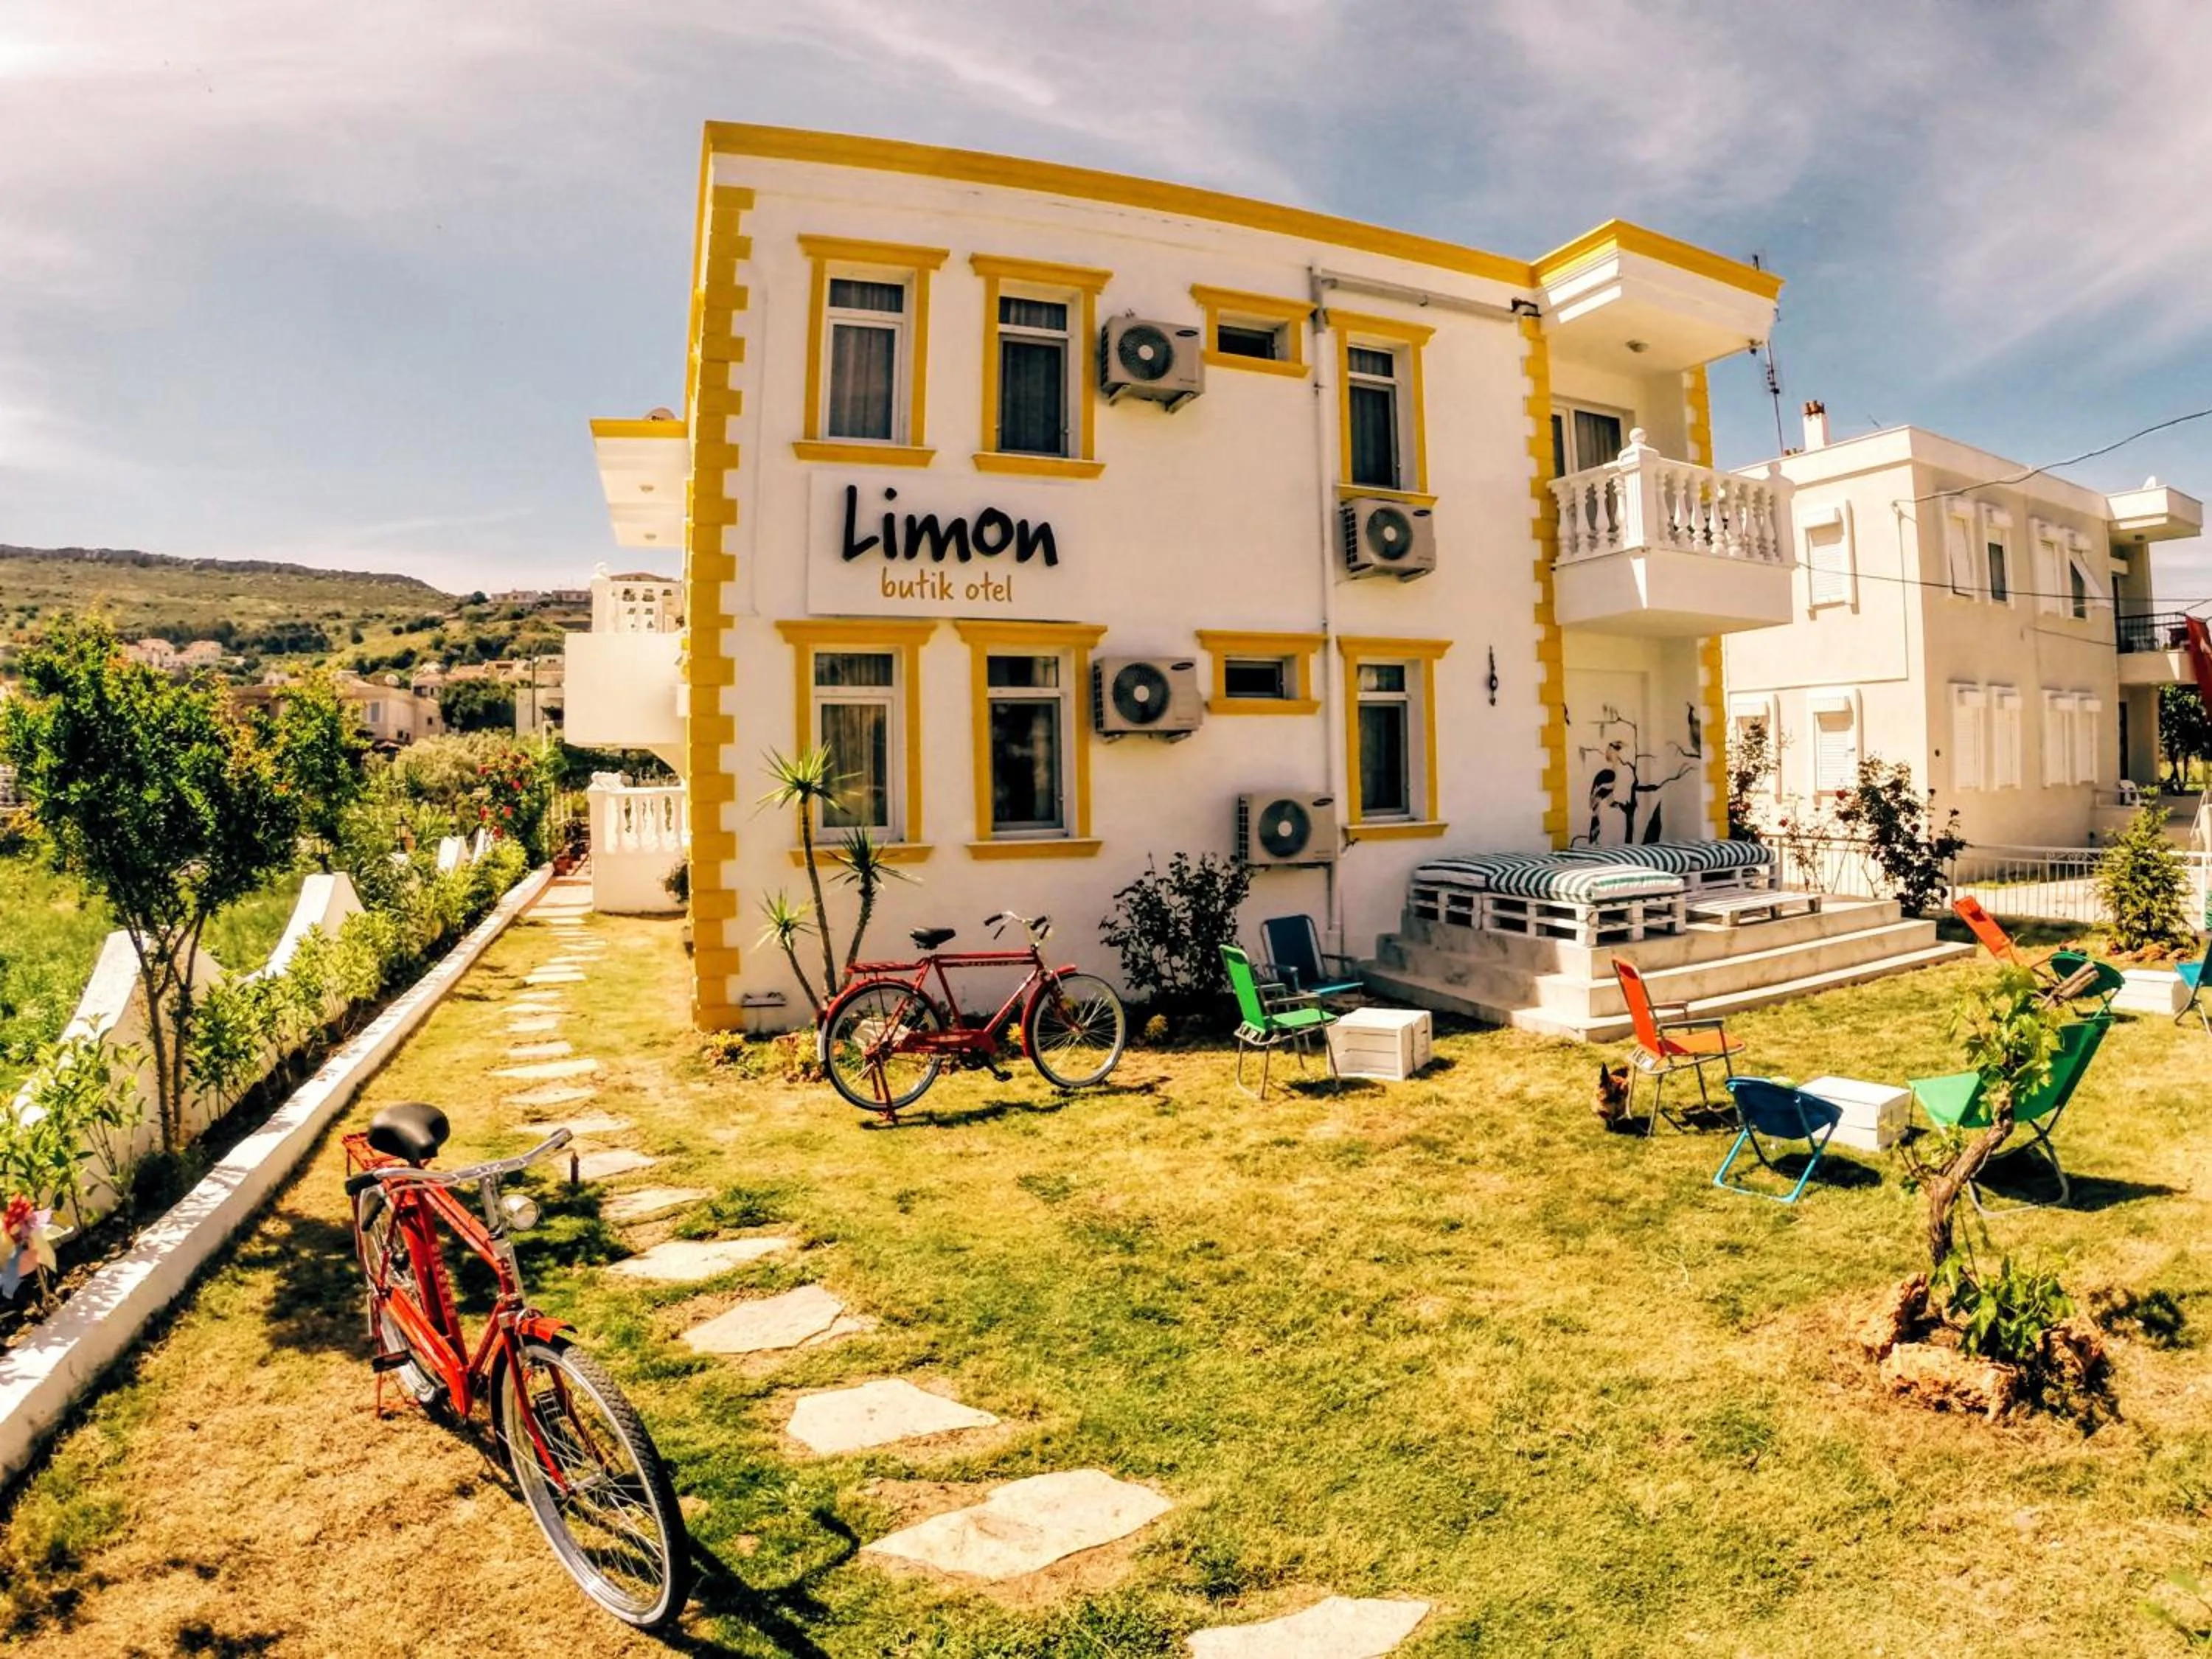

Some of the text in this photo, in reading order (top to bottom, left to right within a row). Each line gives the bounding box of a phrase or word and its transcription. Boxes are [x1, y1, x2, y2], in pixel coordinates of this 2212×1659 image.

[842, 484, 1058, 567] Limon
[881, 566, 1012, 602] butik otel
